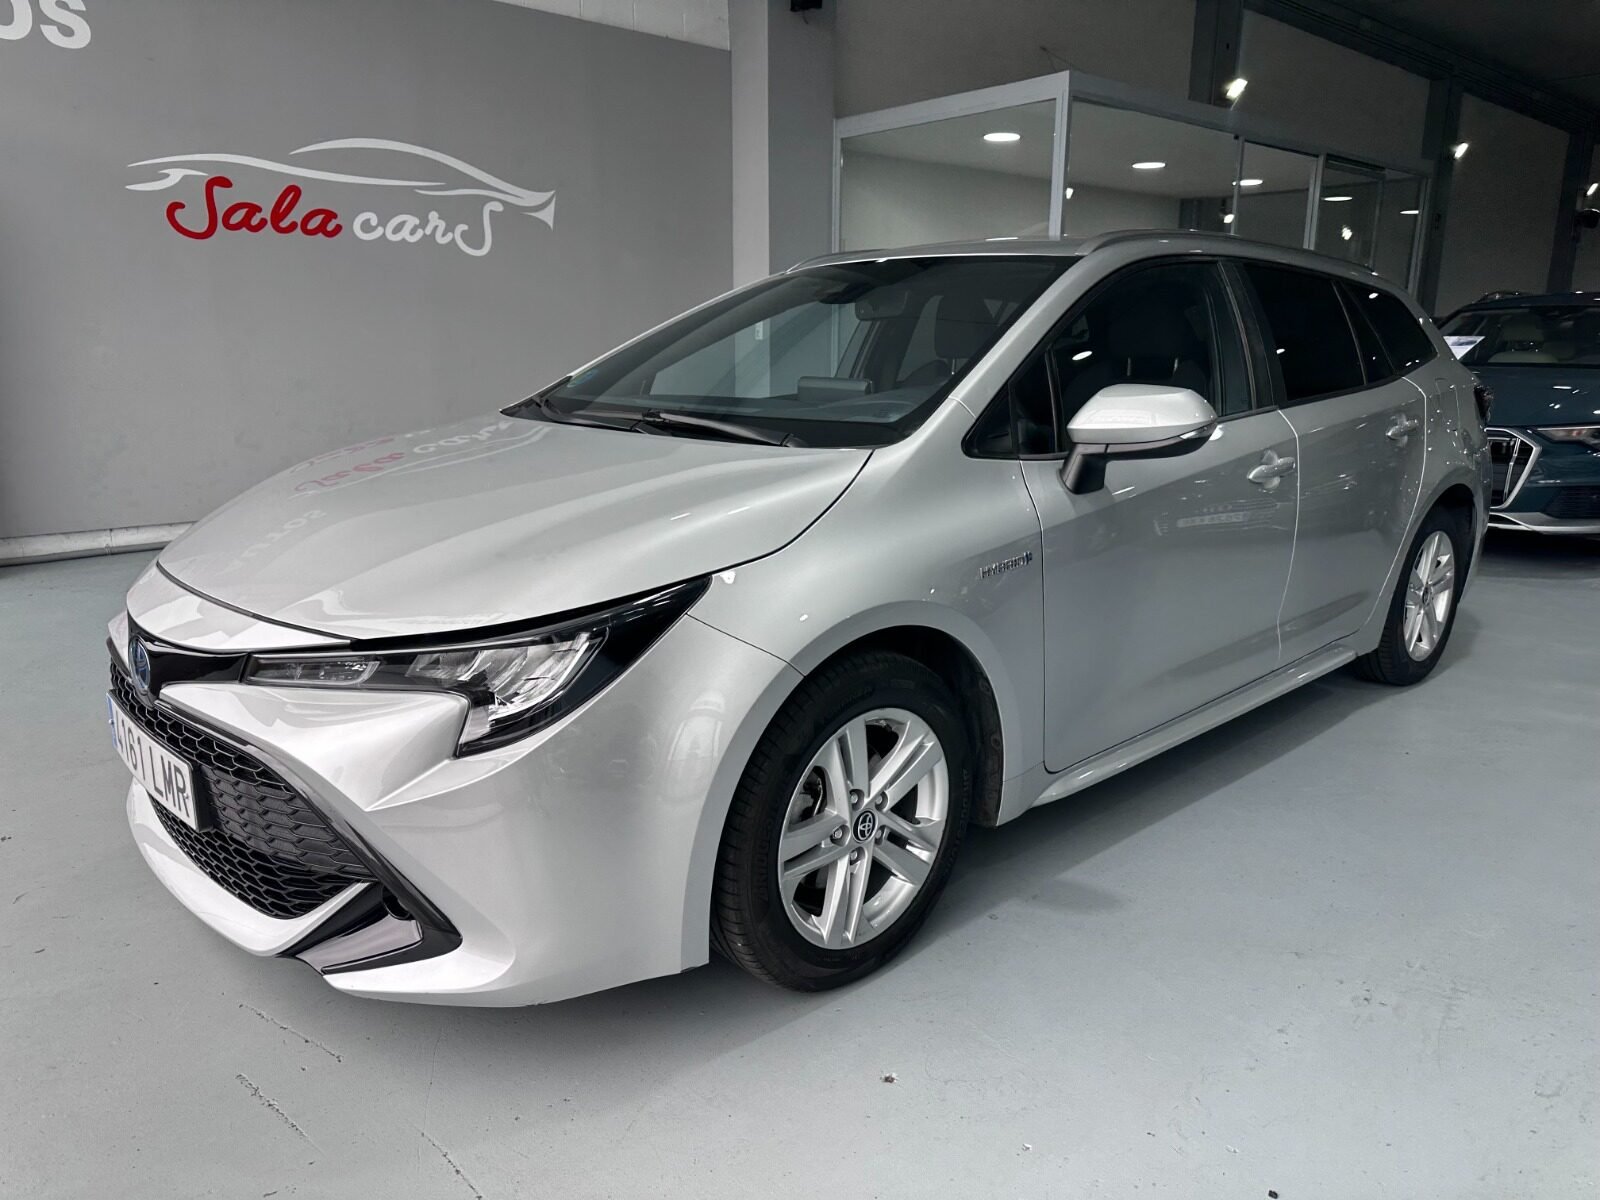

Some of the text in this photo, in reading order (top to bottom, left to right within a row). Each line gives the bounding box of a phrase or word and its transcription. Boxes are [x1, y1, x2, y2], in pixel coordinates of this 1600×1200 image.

[166, 176, 343, 240] Sala
[115, 710, 190, 818] 4161 LMR
